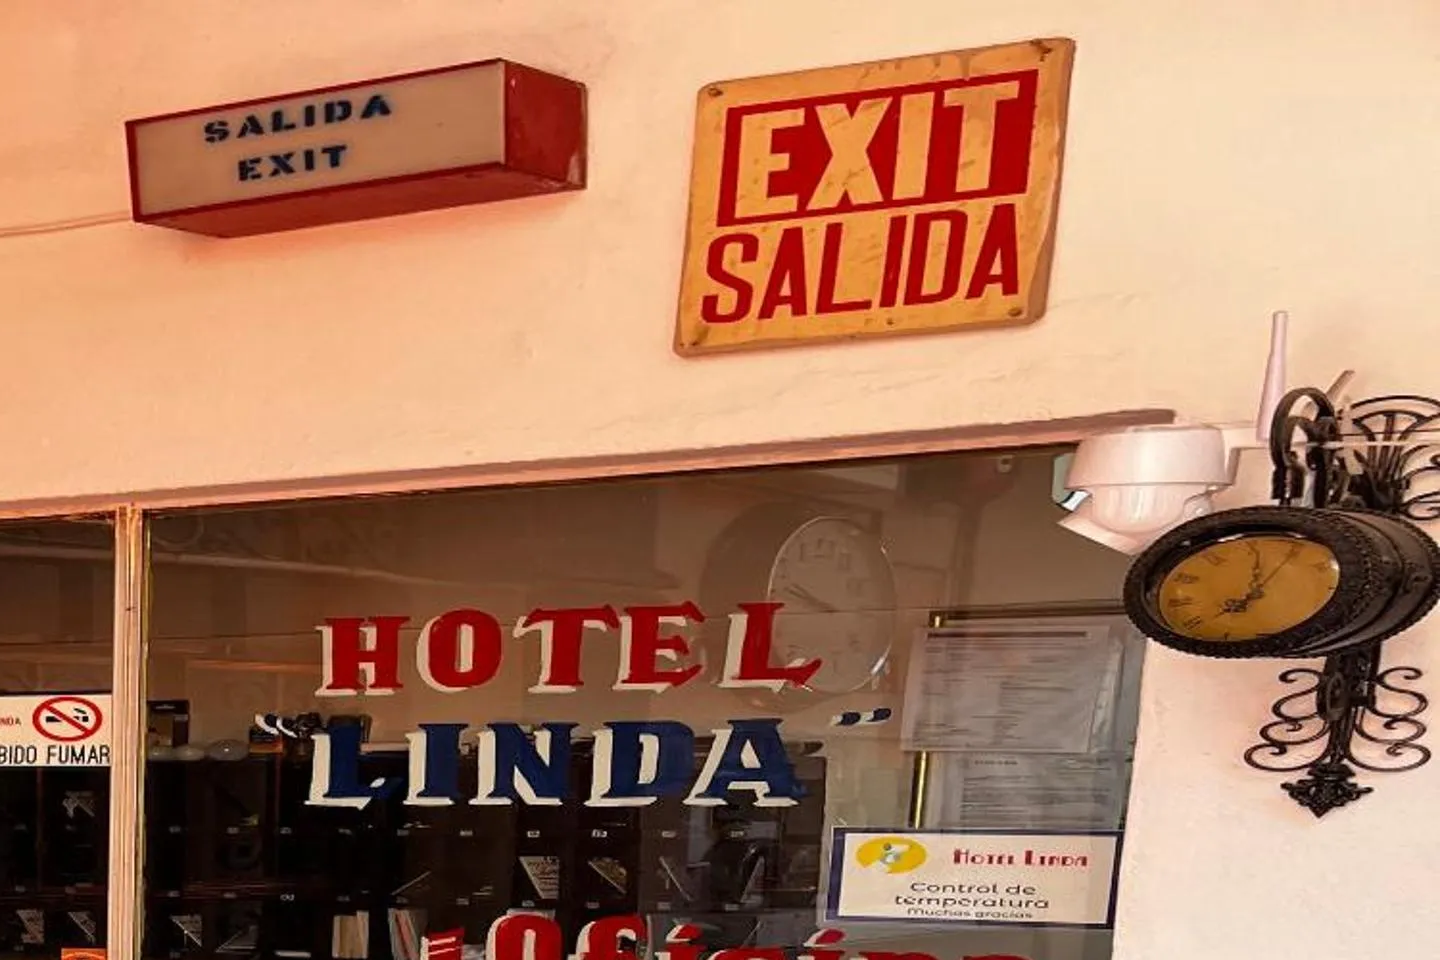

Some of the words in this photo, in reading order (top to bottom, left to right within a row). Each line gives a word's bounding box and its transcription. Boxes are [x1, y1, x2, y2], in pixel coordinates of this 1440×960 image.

[203, 94, 393, 145] SALIDA
[237, 145, 348, 182] EXIT
[737, 81, 1021, 216] EXIT
[700, 203, 1022, 325] SALIDA
[314, 601, 822, 696] HOTEL
[46, 744, 110, 765] FUMAR
[895, 895, 1049, 910] temperatura
[910, 881, 998, 895] Control
[1005, 883, 1036, 896] de
[907, 907, 971, 918] Muchas
[974, 909, 1033, 920] gracias
